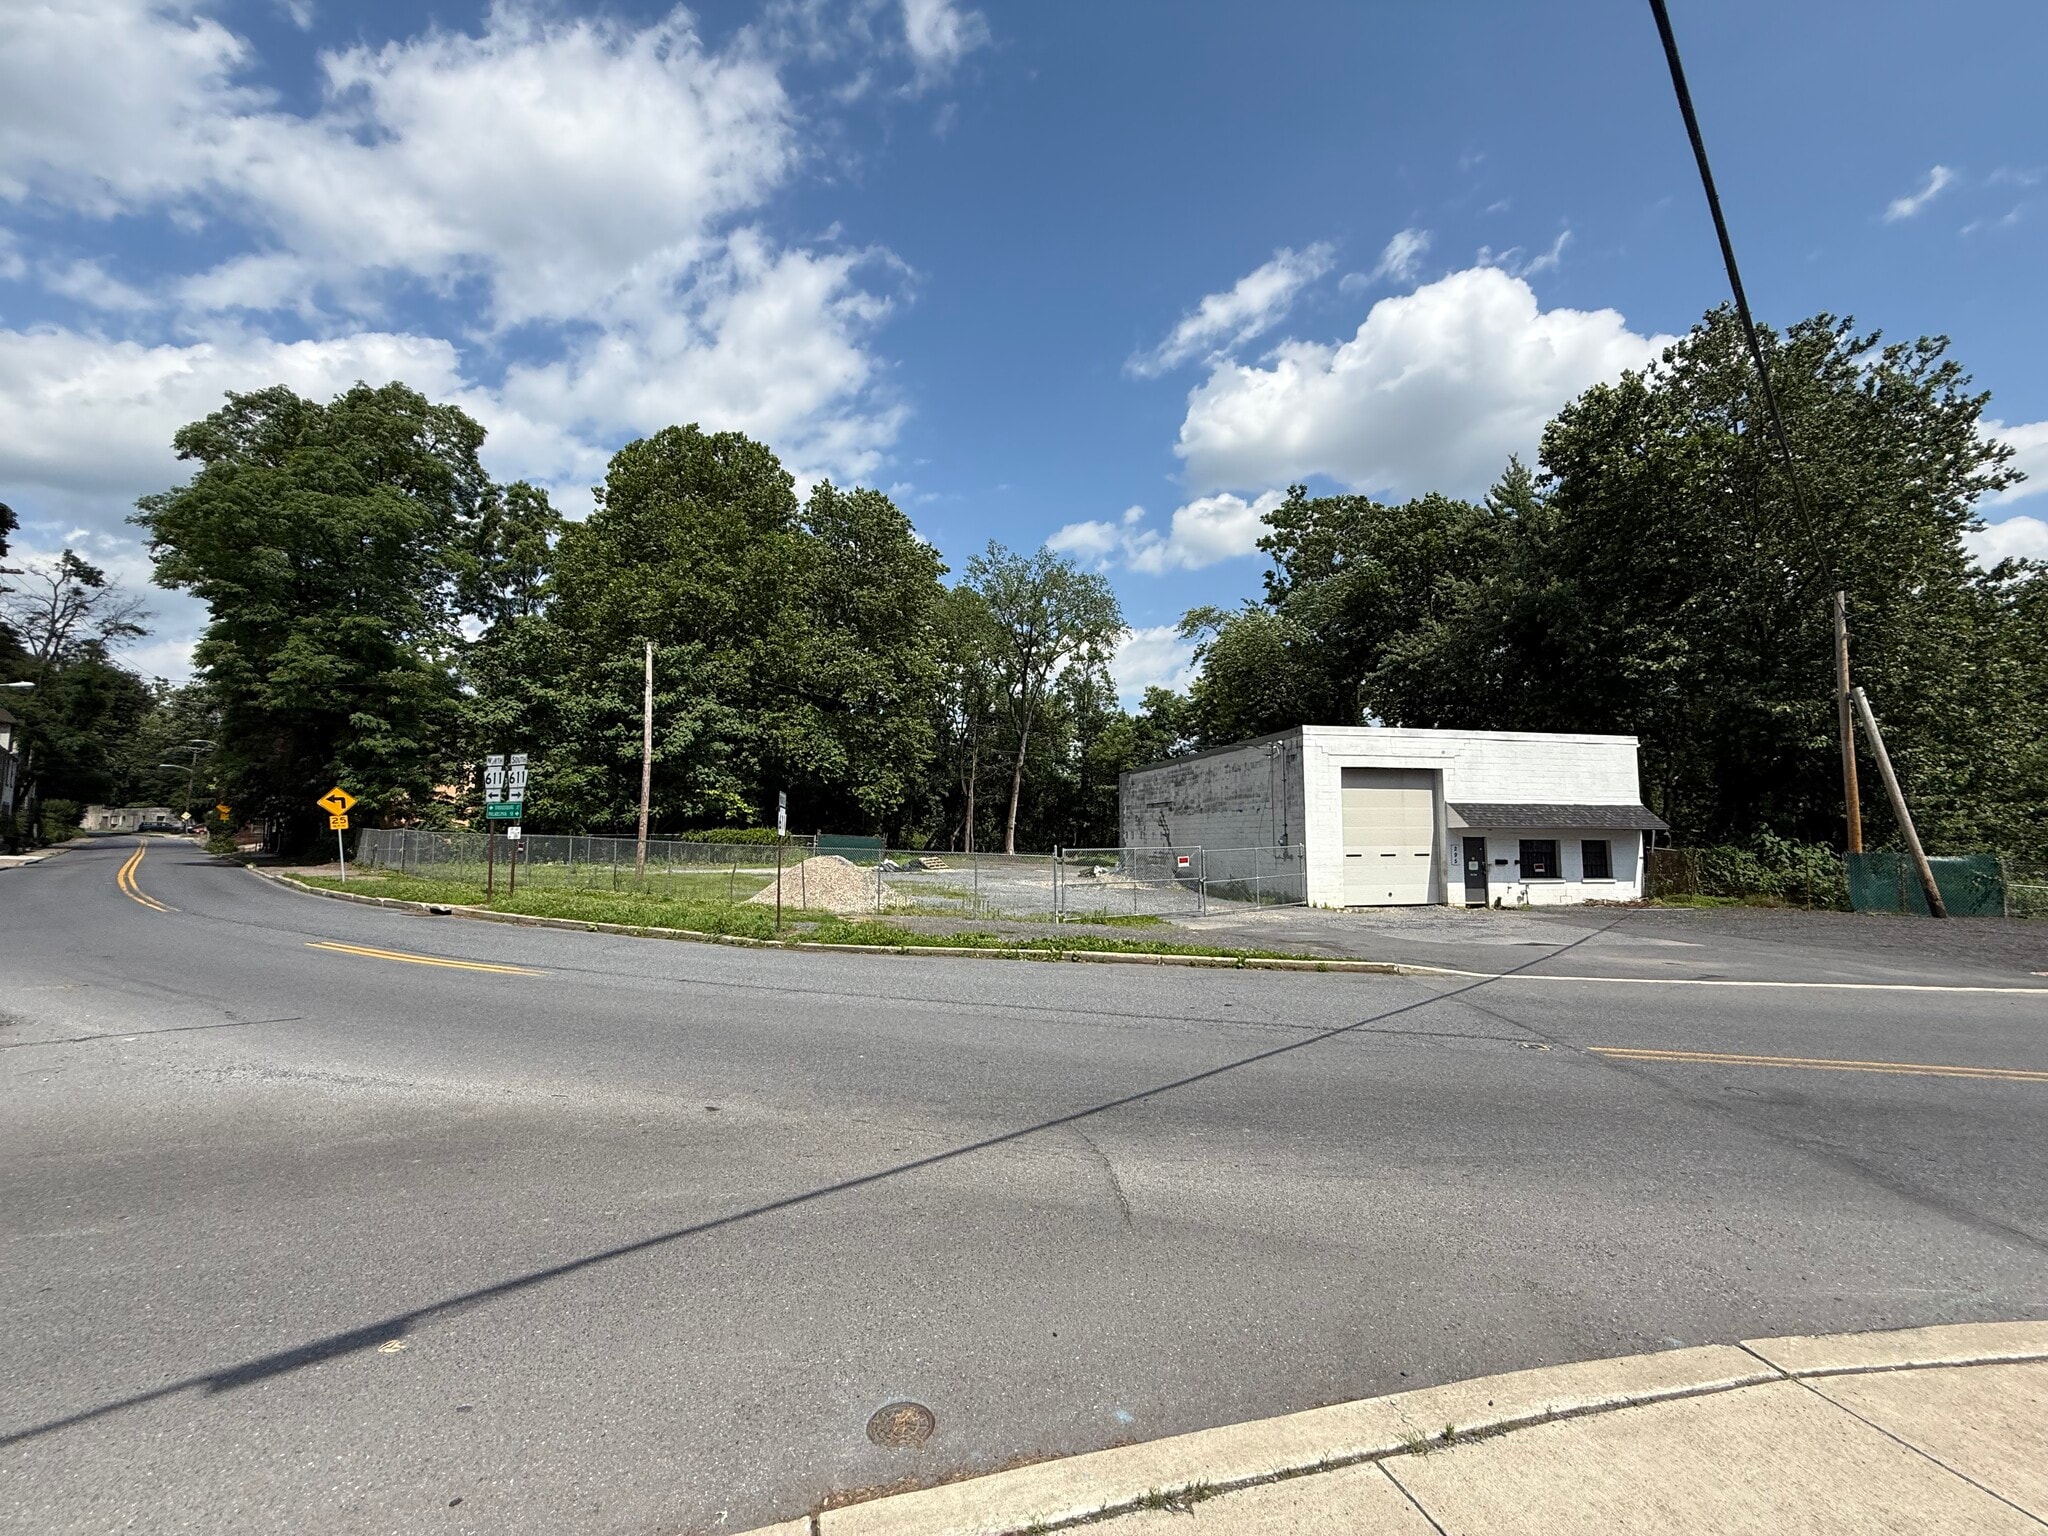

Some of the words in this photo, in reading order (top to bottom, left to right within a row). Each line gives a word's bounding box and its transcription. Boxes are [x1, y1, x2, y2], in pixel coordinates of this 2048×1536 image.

[511, 755, 527, 764] SOUTH
[485, 771, 502, 785] 611
[509, 770, 525, 784] 611
[331, 816, 347, 824] 25
